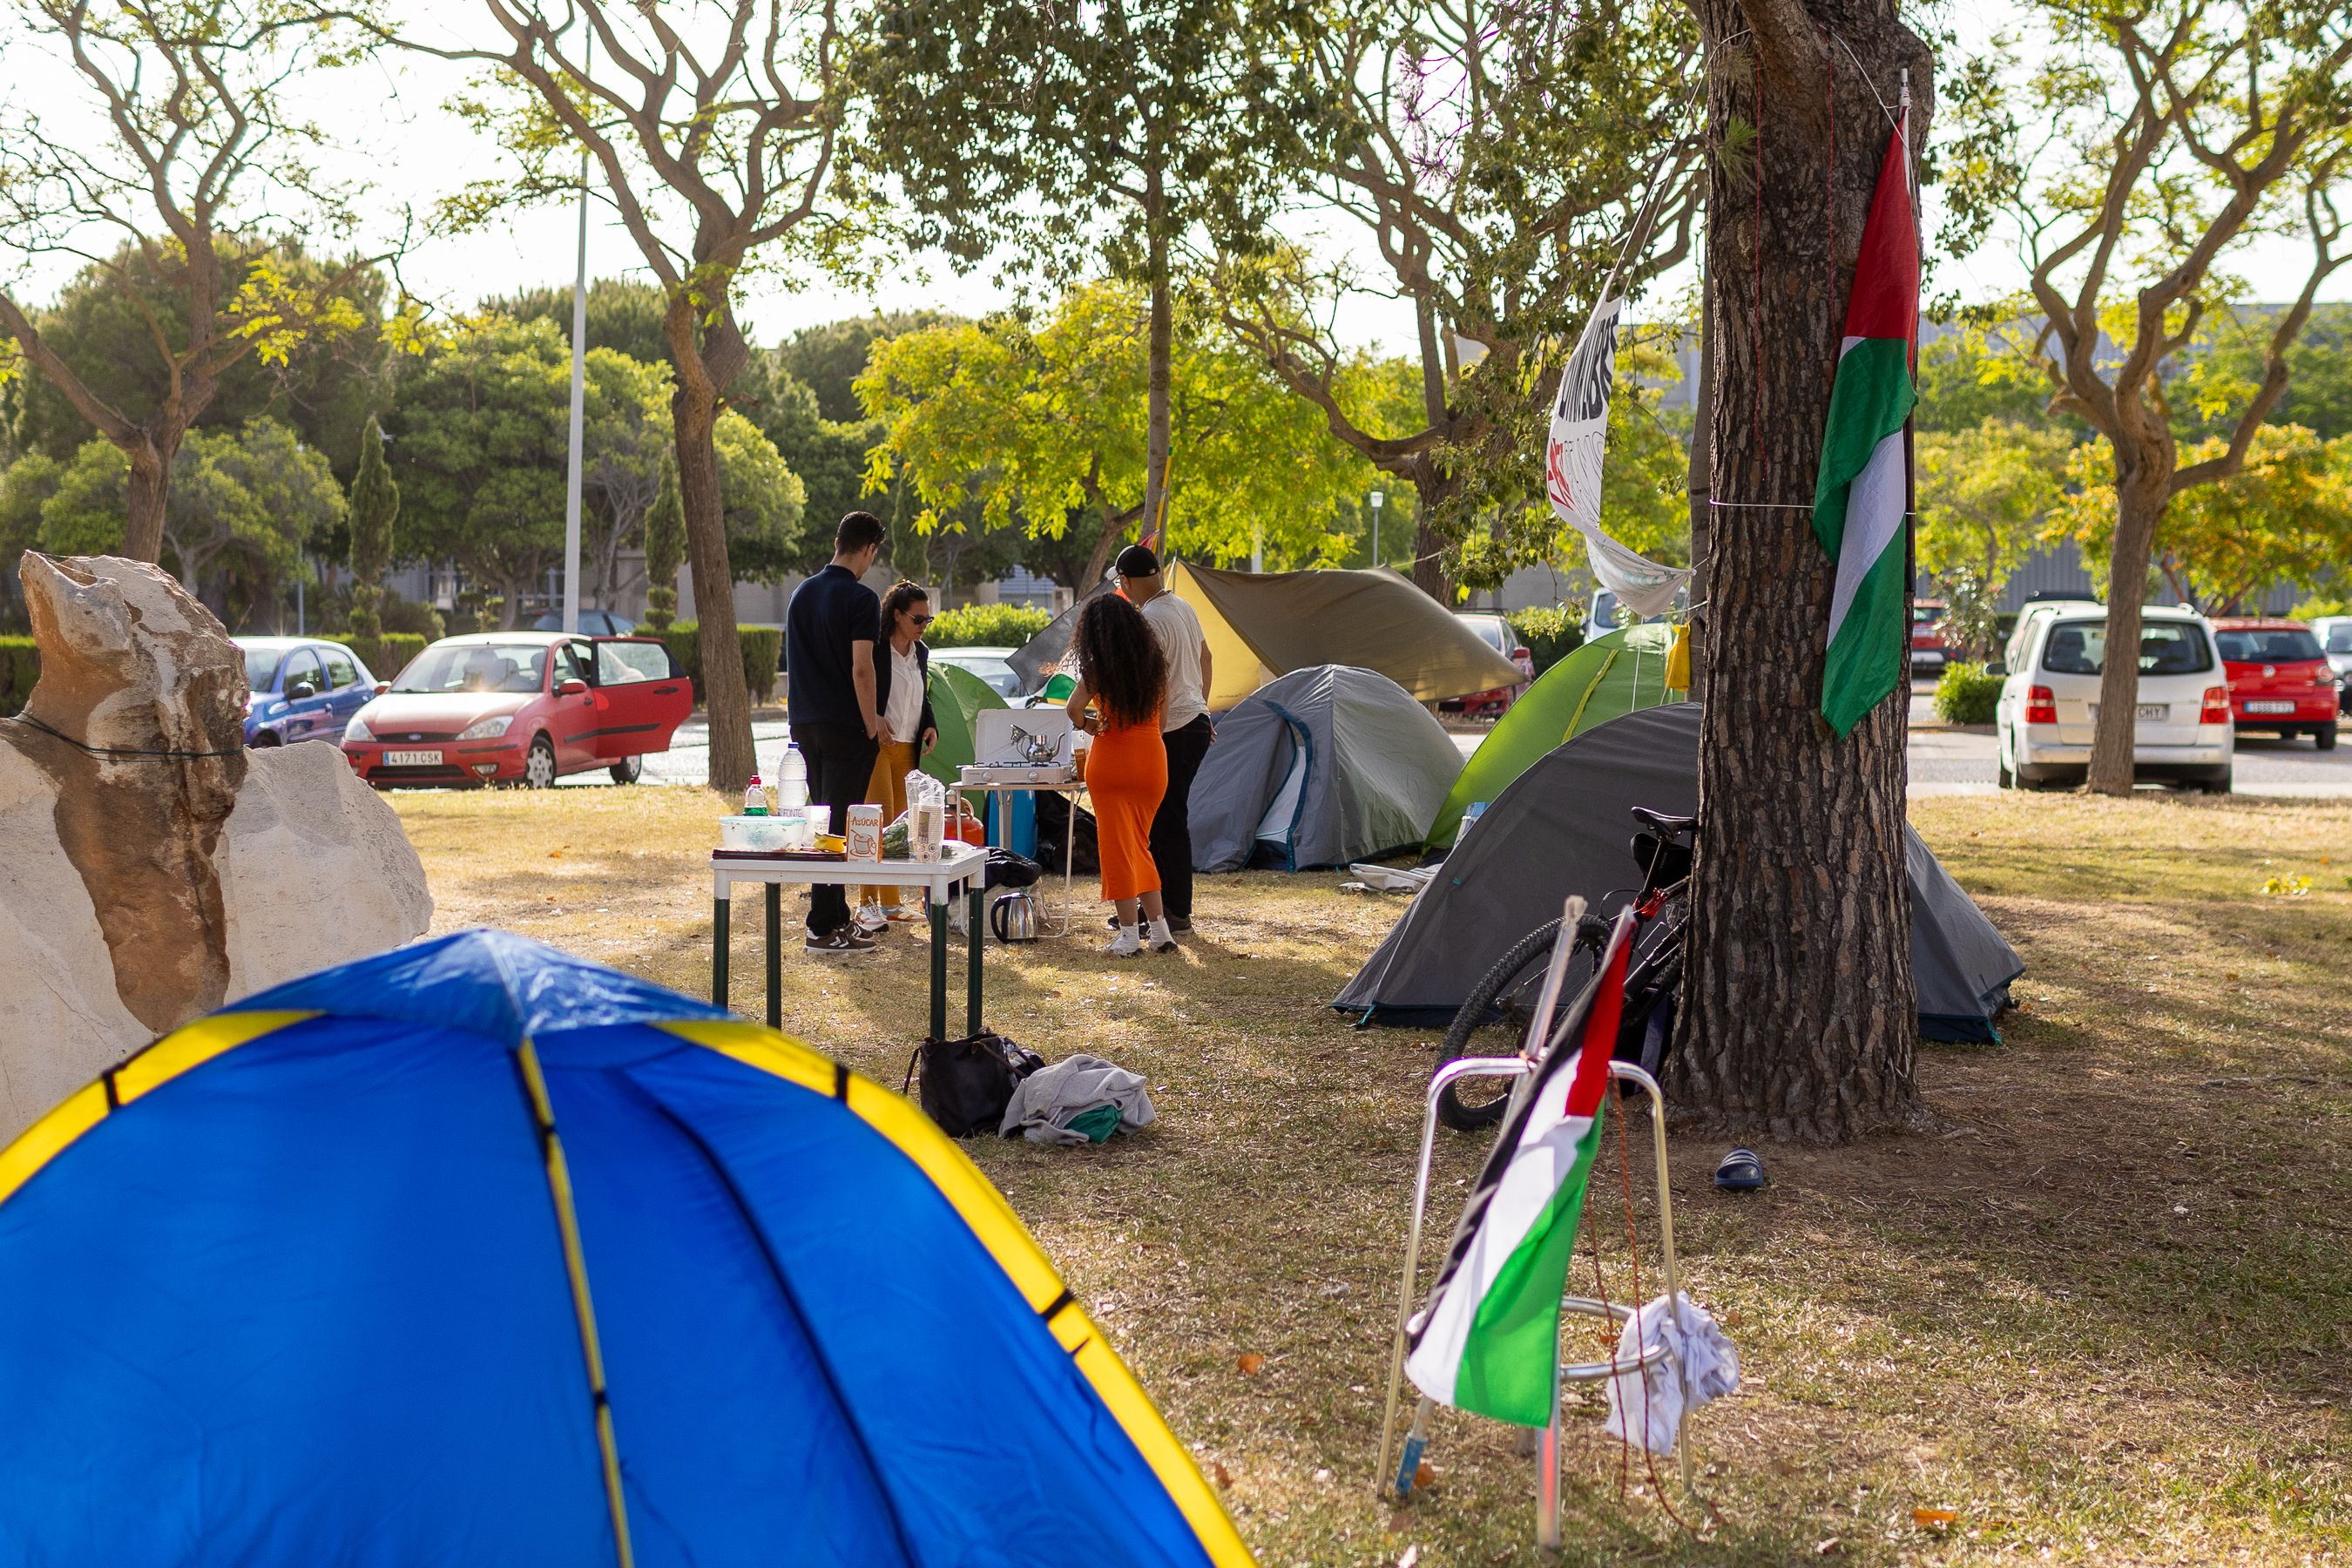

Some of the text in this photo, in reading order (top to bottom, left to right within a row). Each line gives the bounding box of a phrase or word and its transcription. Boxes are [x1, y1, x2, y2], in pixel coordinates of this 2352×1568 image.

[2138, 706, 2161, 719] CHY
[391, 752, 440, 764] 4171 CSK
